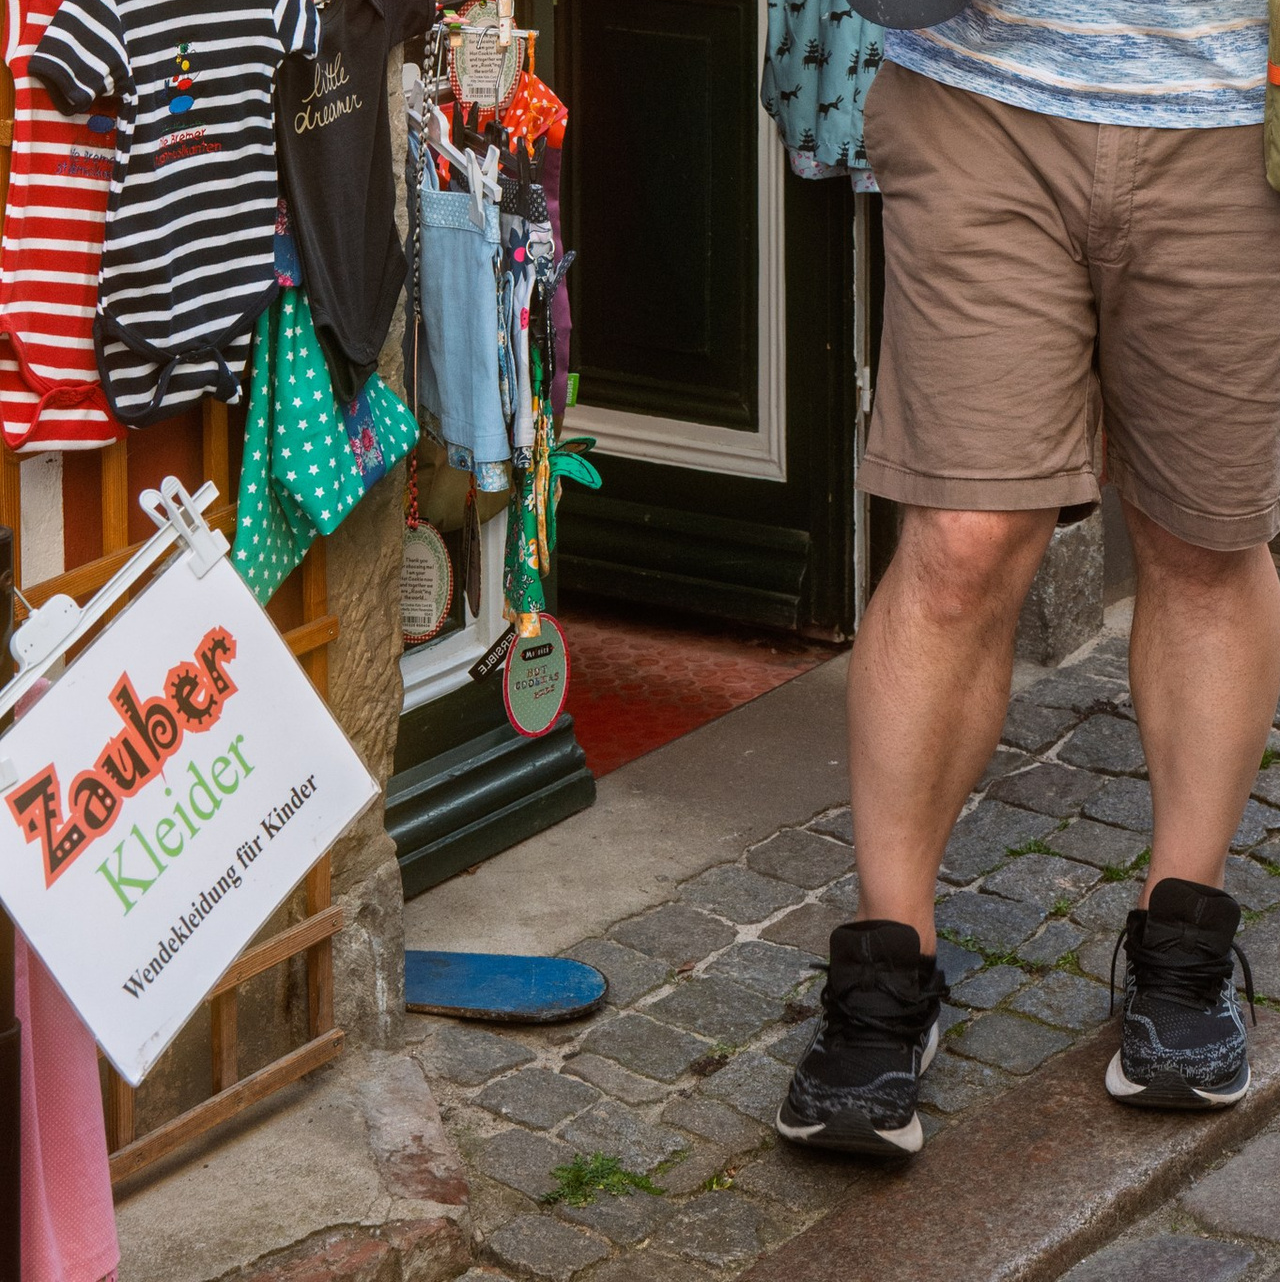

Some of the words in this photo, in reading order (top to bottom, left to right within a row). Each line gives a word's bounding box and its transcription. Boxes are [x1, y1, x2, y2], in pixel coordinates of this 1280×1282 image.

[294, 94, 363, 134] dreamer
[302, 52, 349, 103] little
[171, 128, 208, 146] Bremer
[8, 628, 237, 886] Zauber
[95, 734, 255, 917] Kleider
[121, 865, 243, 1001] Wendekleidung
[235, 833, 264, 872] für
[259, 774, 318, 842] Kinder
